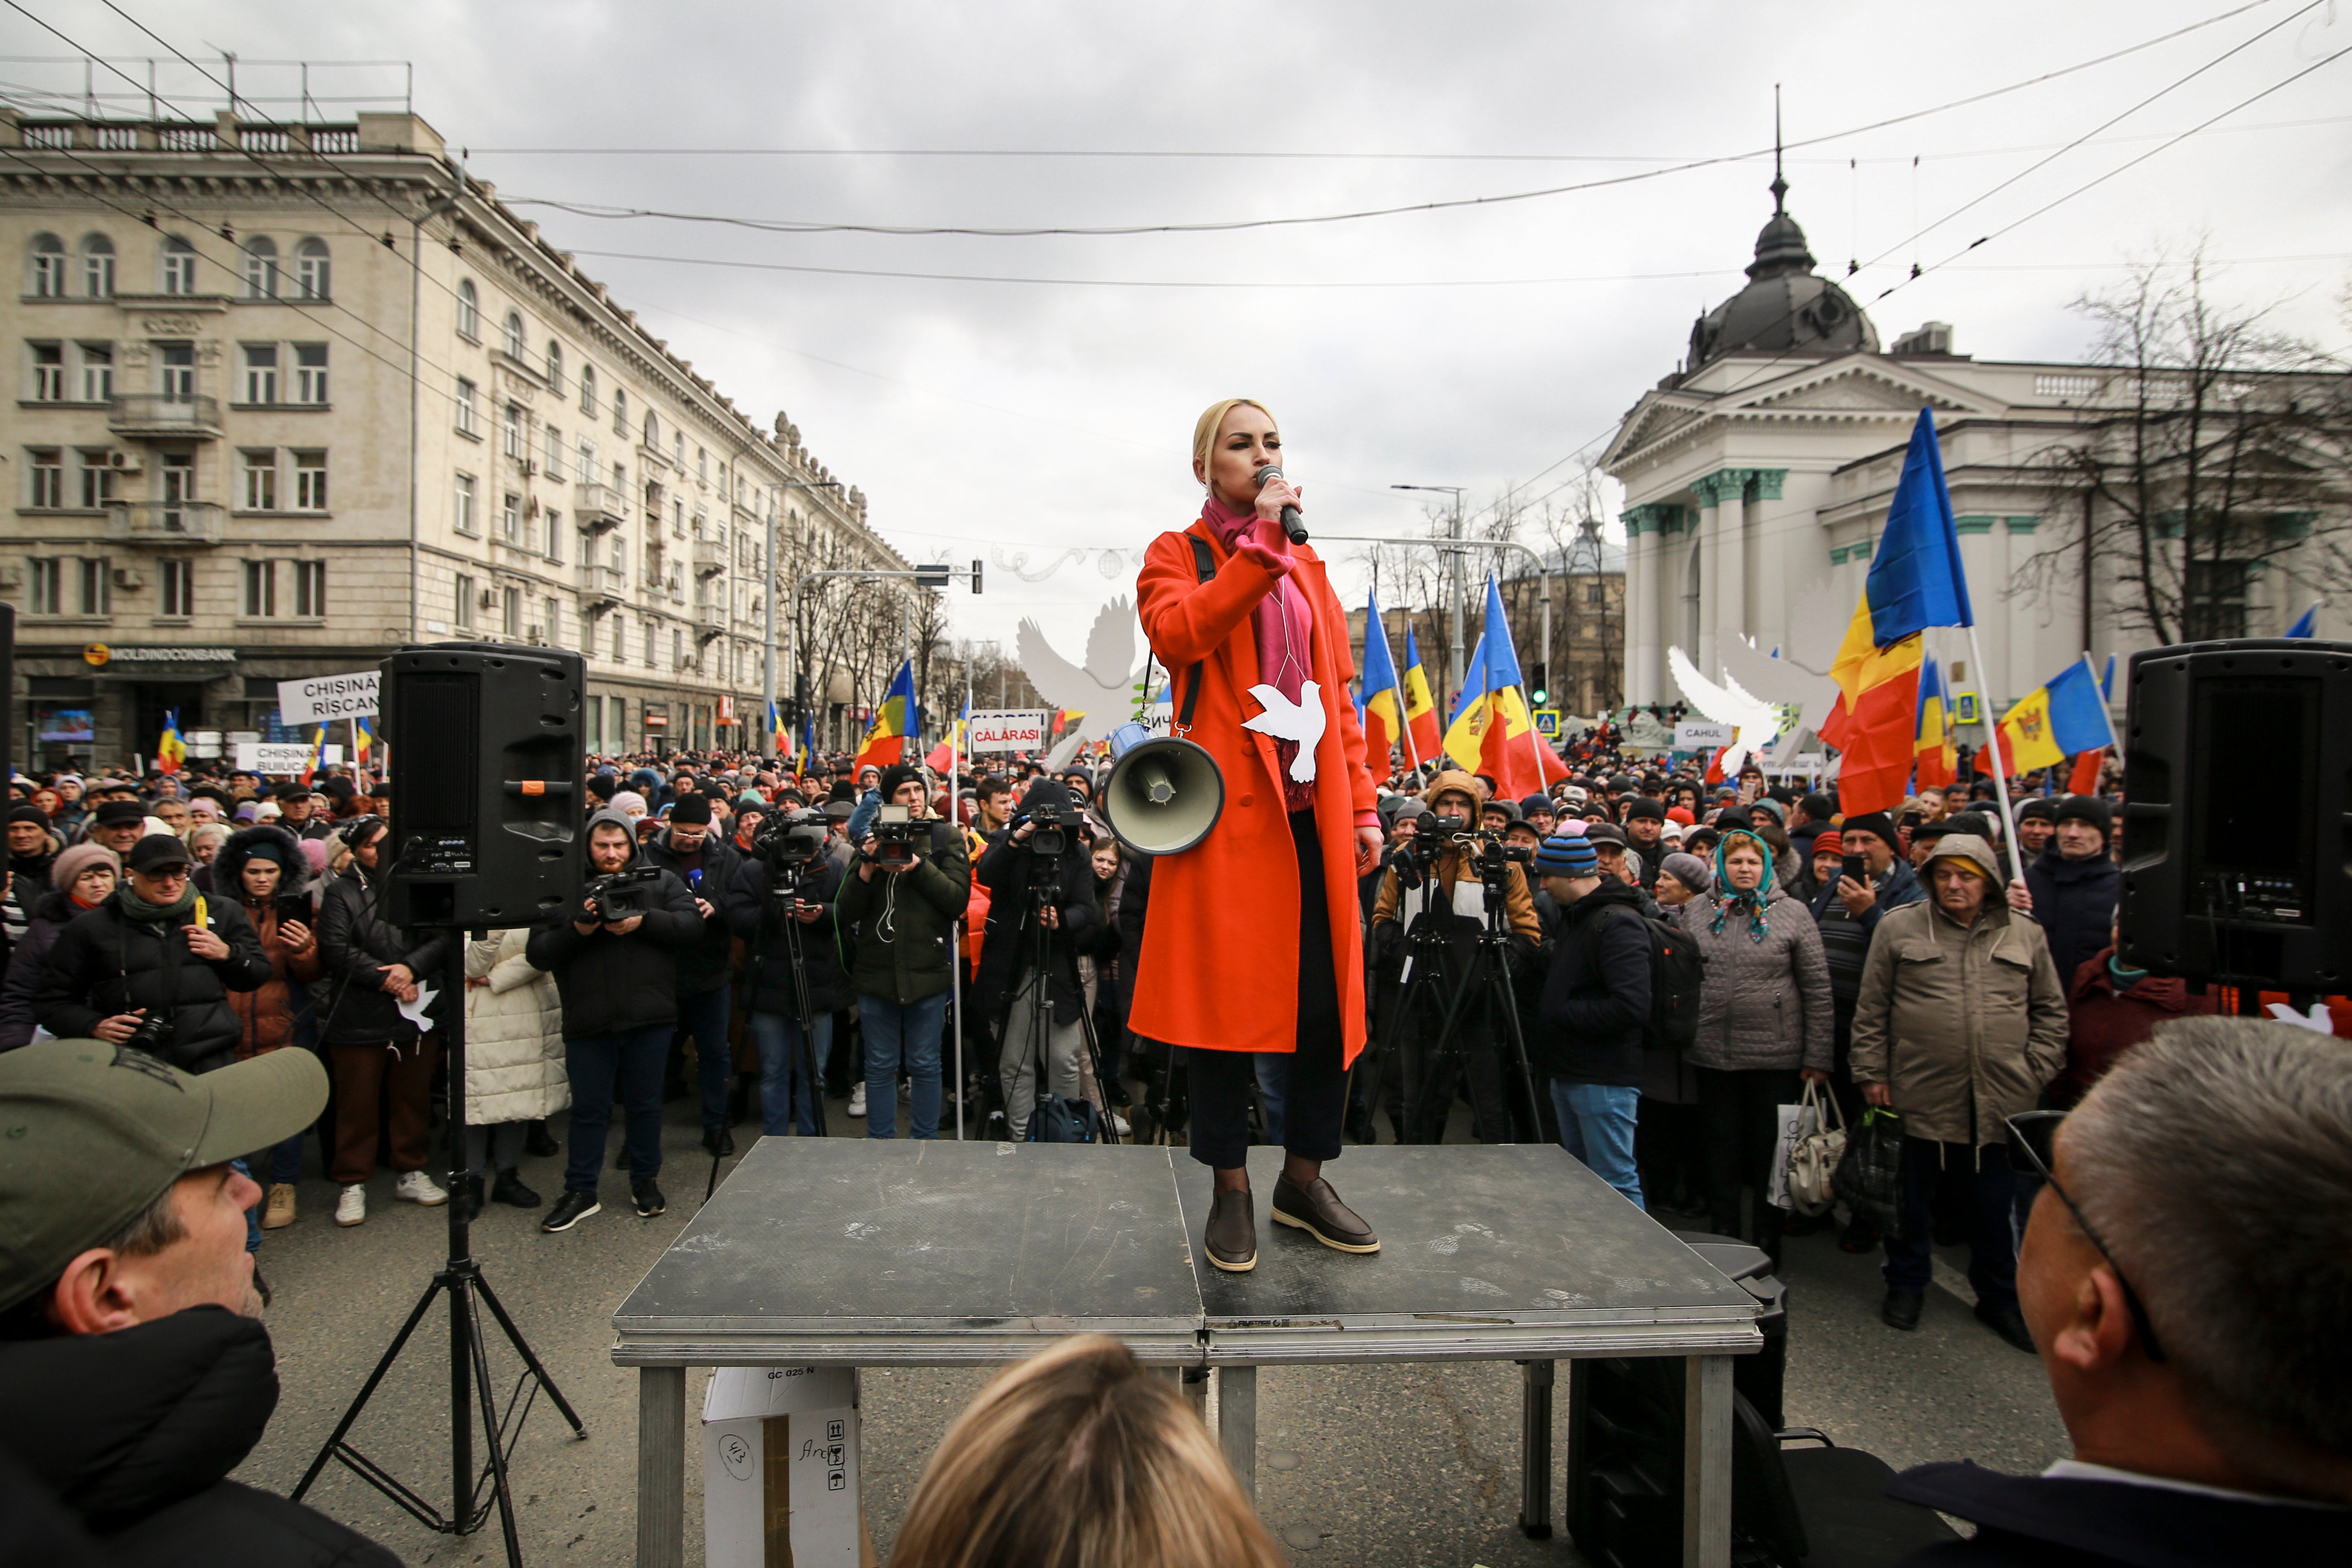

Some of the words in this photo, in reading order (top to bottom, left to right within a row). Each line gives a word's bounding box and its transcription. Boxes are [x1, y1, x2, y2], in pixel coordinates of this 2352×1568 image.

[111, 648, 236, 661] MOLDINDCONBANK
[304, 674, 381, 697] CHIȘINĂ
[1685, 729, 1722, 737] CAHUL
[768, 1371, 783, 1379] GC
[786, 1368, 803, 1377] 025
